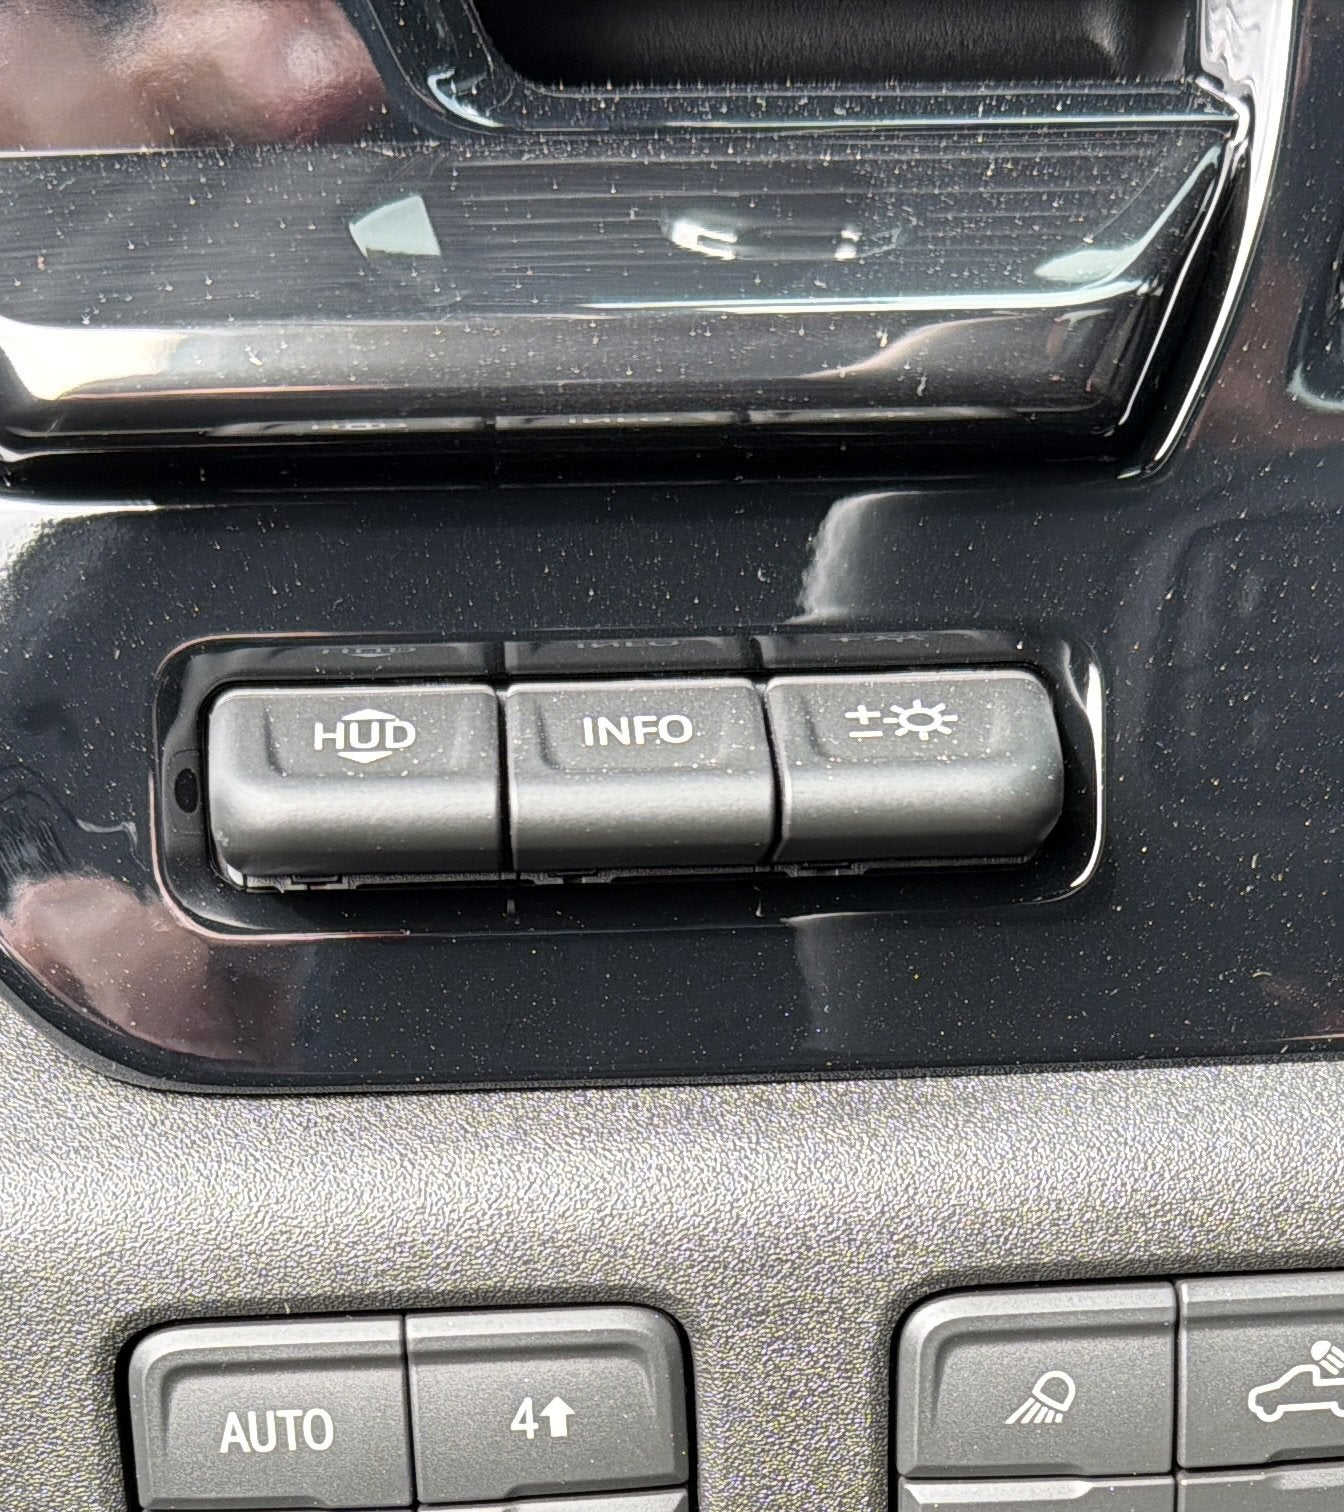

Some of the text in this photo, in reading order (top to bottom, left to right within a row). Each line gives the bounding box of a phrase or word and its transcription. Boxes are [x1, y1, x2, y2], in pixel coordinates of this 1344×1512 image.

[312, 719, 417, 752] HUD
[581, 713, 694, 748] INFO
[218, 1406, 335, 1455] AUTO
[509, 1395, 540, 1441] 4
